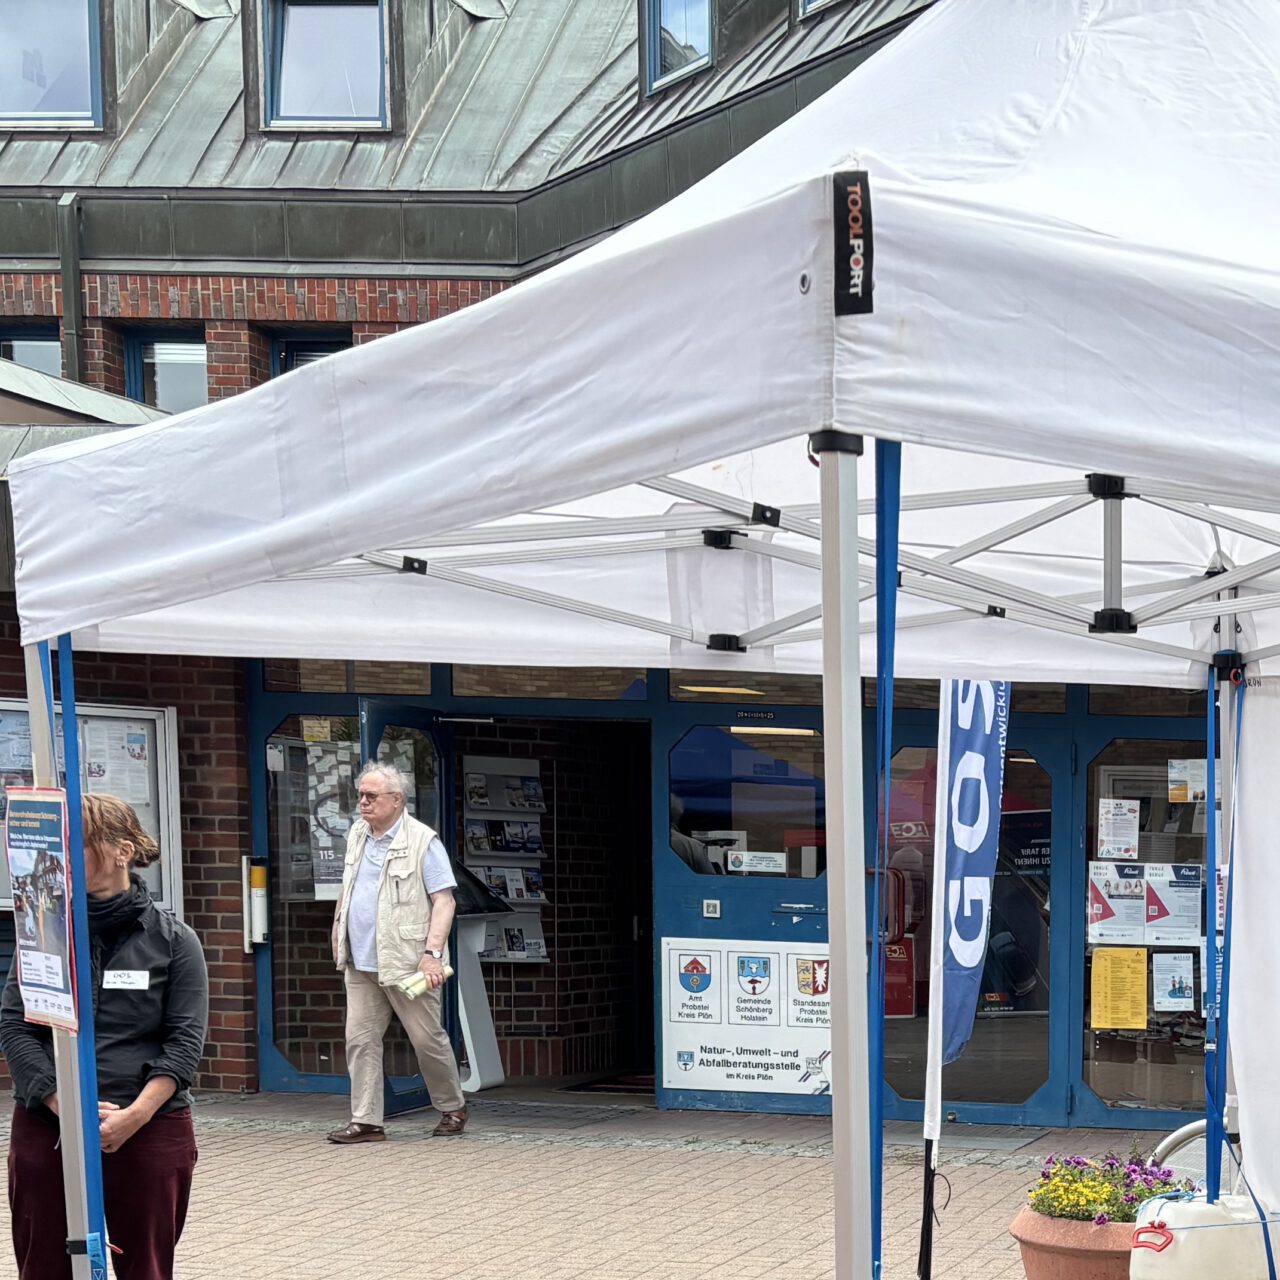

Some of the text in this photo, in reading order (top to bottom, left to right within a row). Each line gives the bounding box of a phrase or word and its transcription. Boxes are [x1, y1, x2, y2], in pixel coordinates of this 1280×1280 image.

[846, 182, 864, 298] TOOLPORT
[319, 850, 335, 860] 115
[736, 997, 772, 1005] Gemeinde
[681, 1002, 710, 1011] Probstei
[735, 1005, 773, 1015] Schönberg
[678, 1012, 713, 1020] Kreis Plön
[799, 1007, 828, 1016] Probstei
[740, 1014, 768, 1022] Holstein
[795, 1016, 814, 1024] Kreis
[736, 1047, 772, 1057] Umwelt
[698, 1058, 801, 1073] Abfallberatungsstelle
[756, 1073, 773, 1081] Plön
